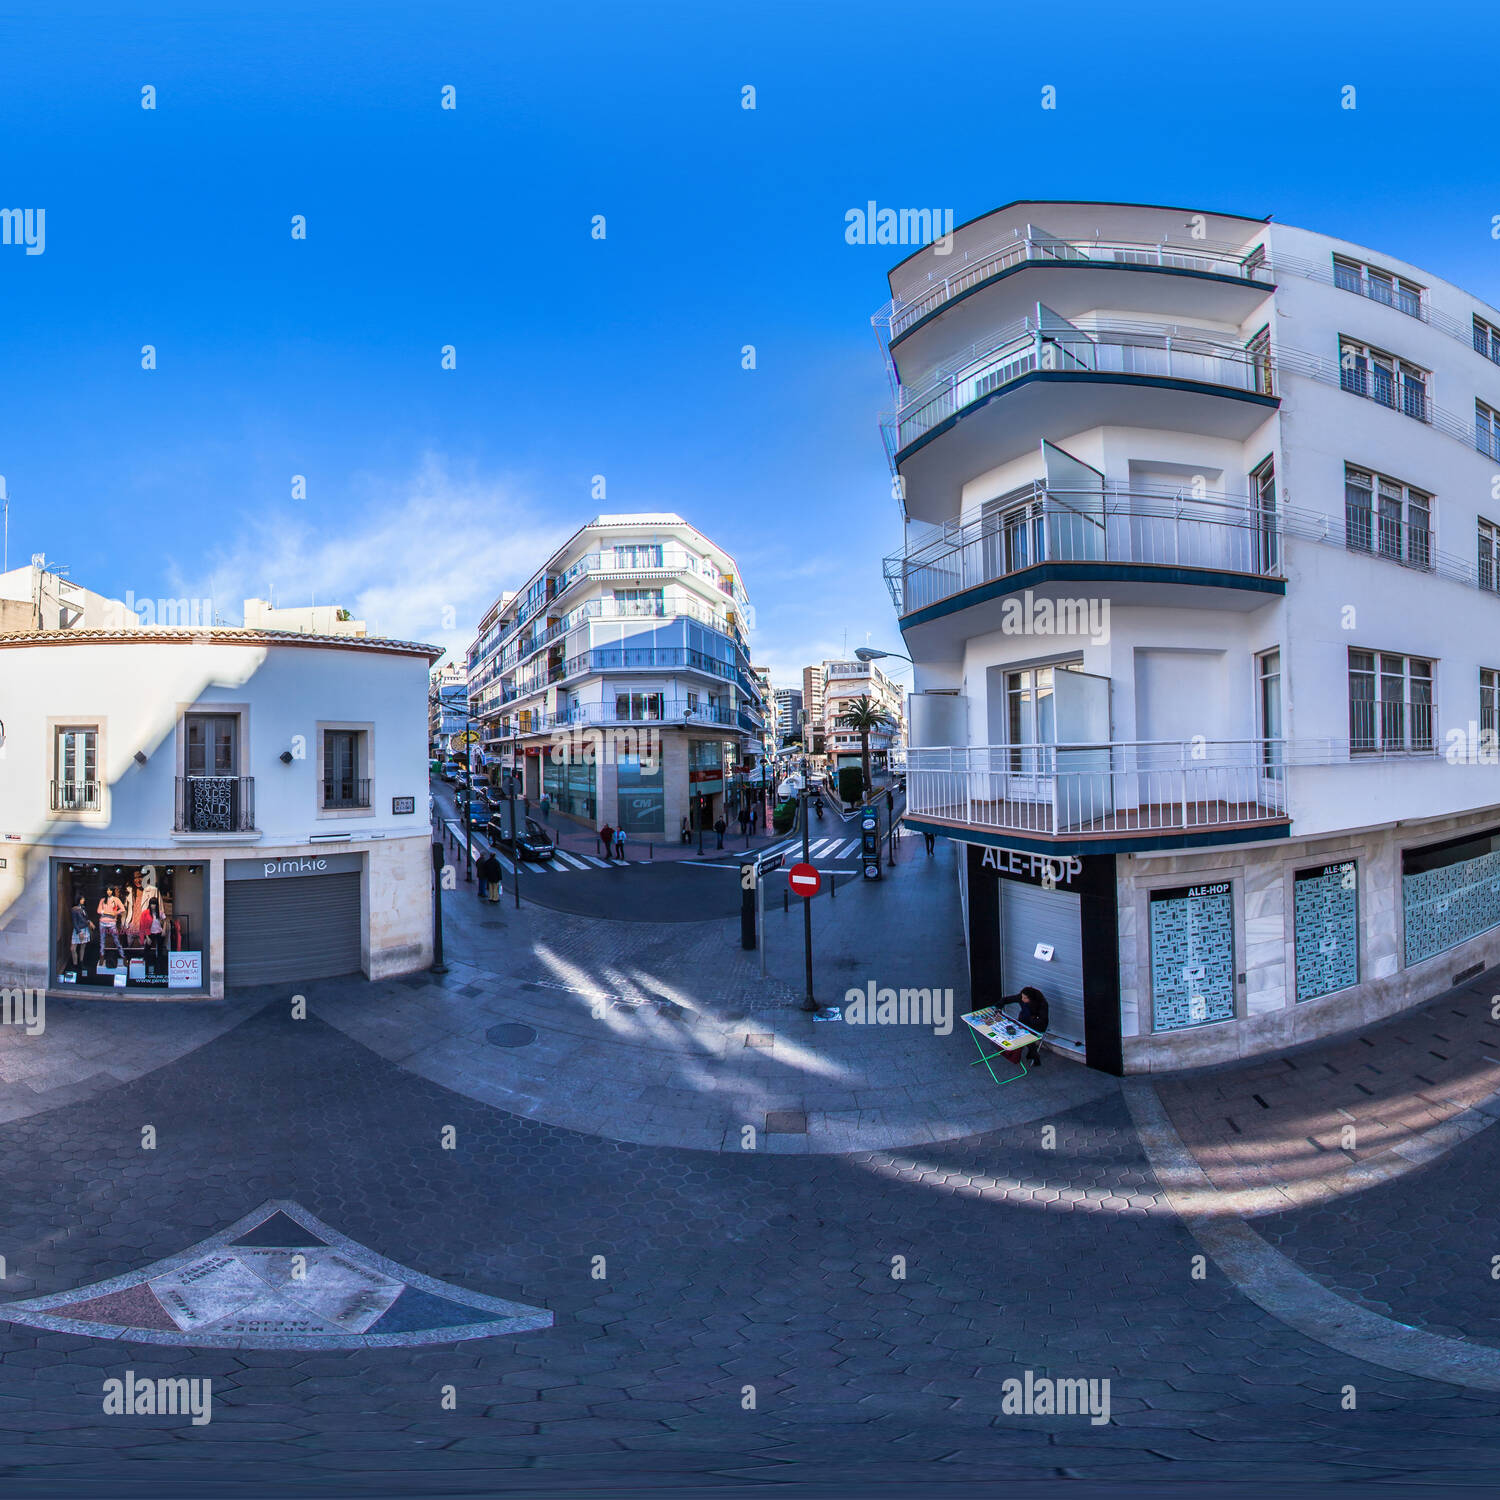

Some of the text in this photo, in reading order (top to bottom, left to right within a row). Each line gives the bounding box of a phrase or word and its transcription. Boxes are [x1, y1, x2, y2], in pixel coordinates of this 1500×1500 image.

[632, 799, 652, 809] CM
[263, 857, 328, 878] pimkie
[981, 847, 1083, 884] ALE-HOP
[1188, 884, 1229, 897] ALE-HOP
[170, 959, 199, 969] LOVE
